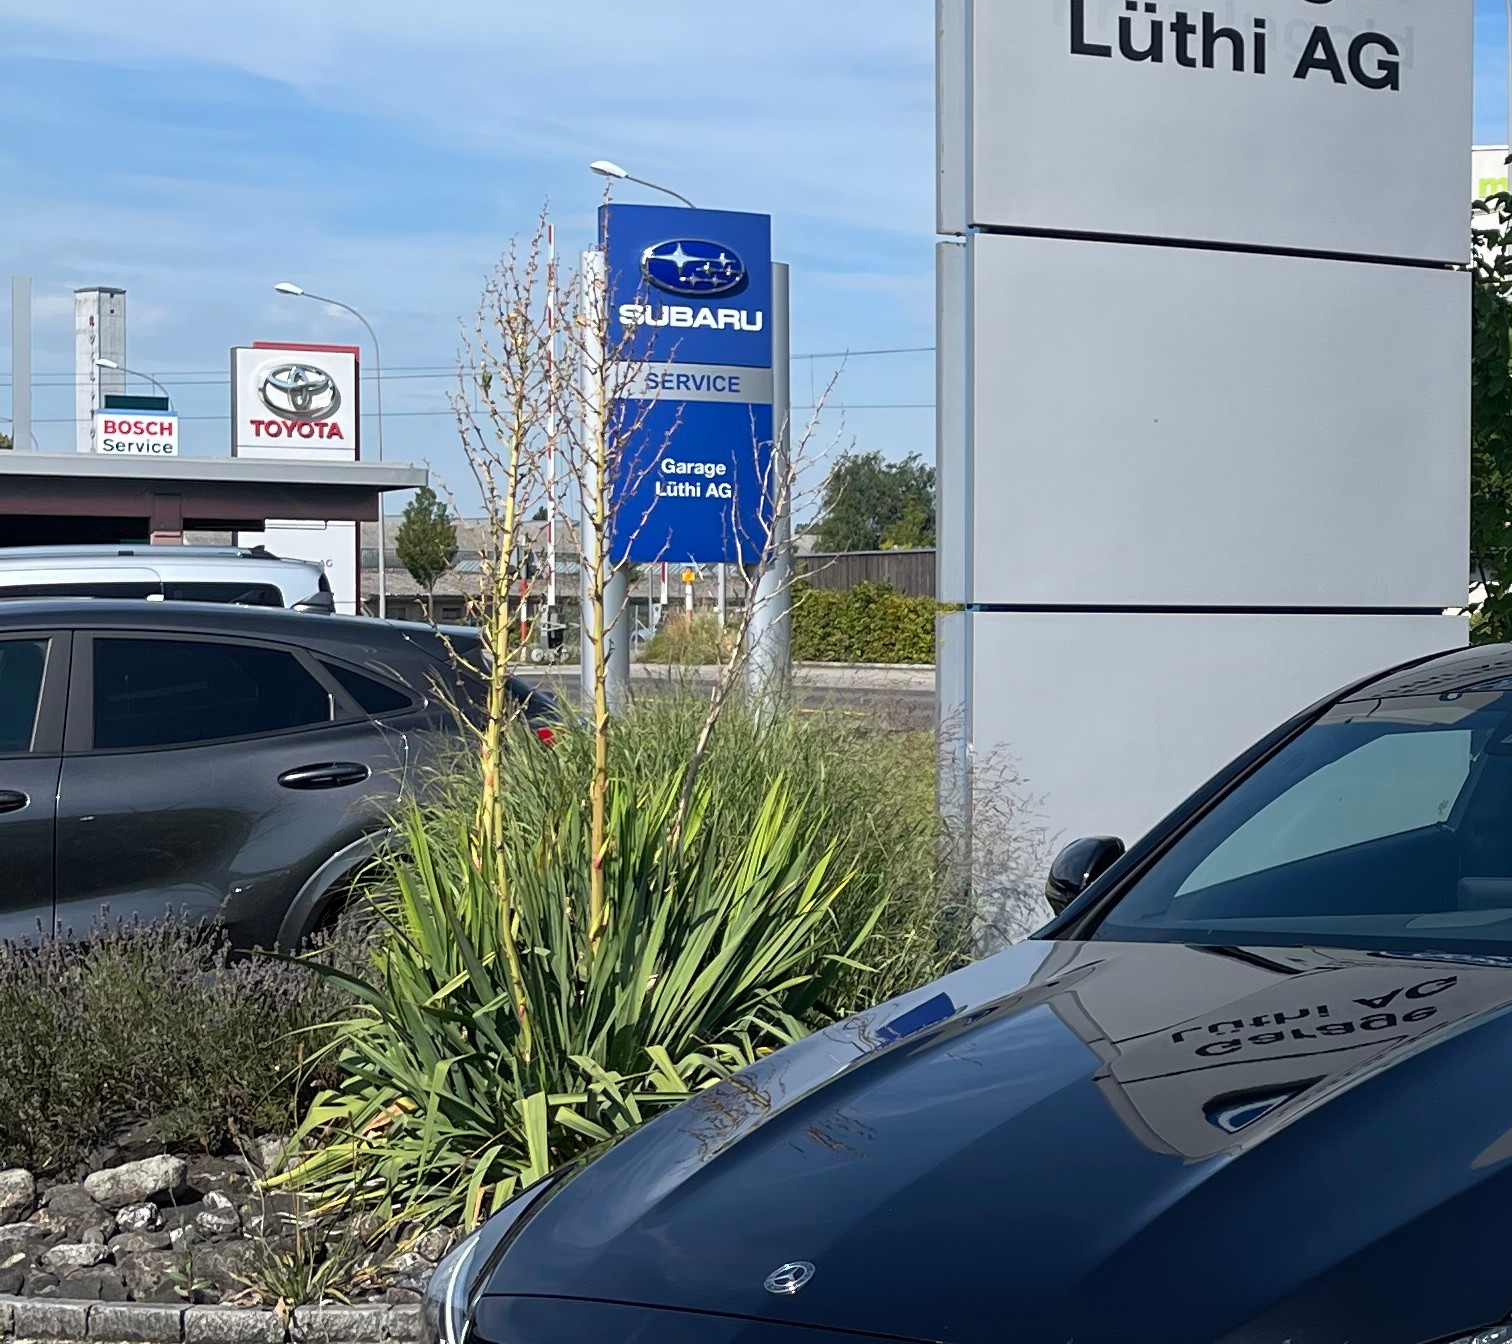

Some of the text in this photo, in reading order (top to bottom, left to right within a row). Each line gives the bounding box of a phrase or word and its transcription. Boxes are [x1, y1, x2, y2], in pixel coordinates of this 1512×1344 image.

[1293, 24, 1400, 92] AG
[619, 304, 762, 331] SUBARU
[646, 372, 741, 393] SERVICE
[103, 419, 173, 437] BOSCH
[250, 419, 344, 439] TOYOTA
[103, 438, 173, 454] Service
[661, 458, 727, 478] Garage
[655, 481, 732, 498] Lüthi AG
